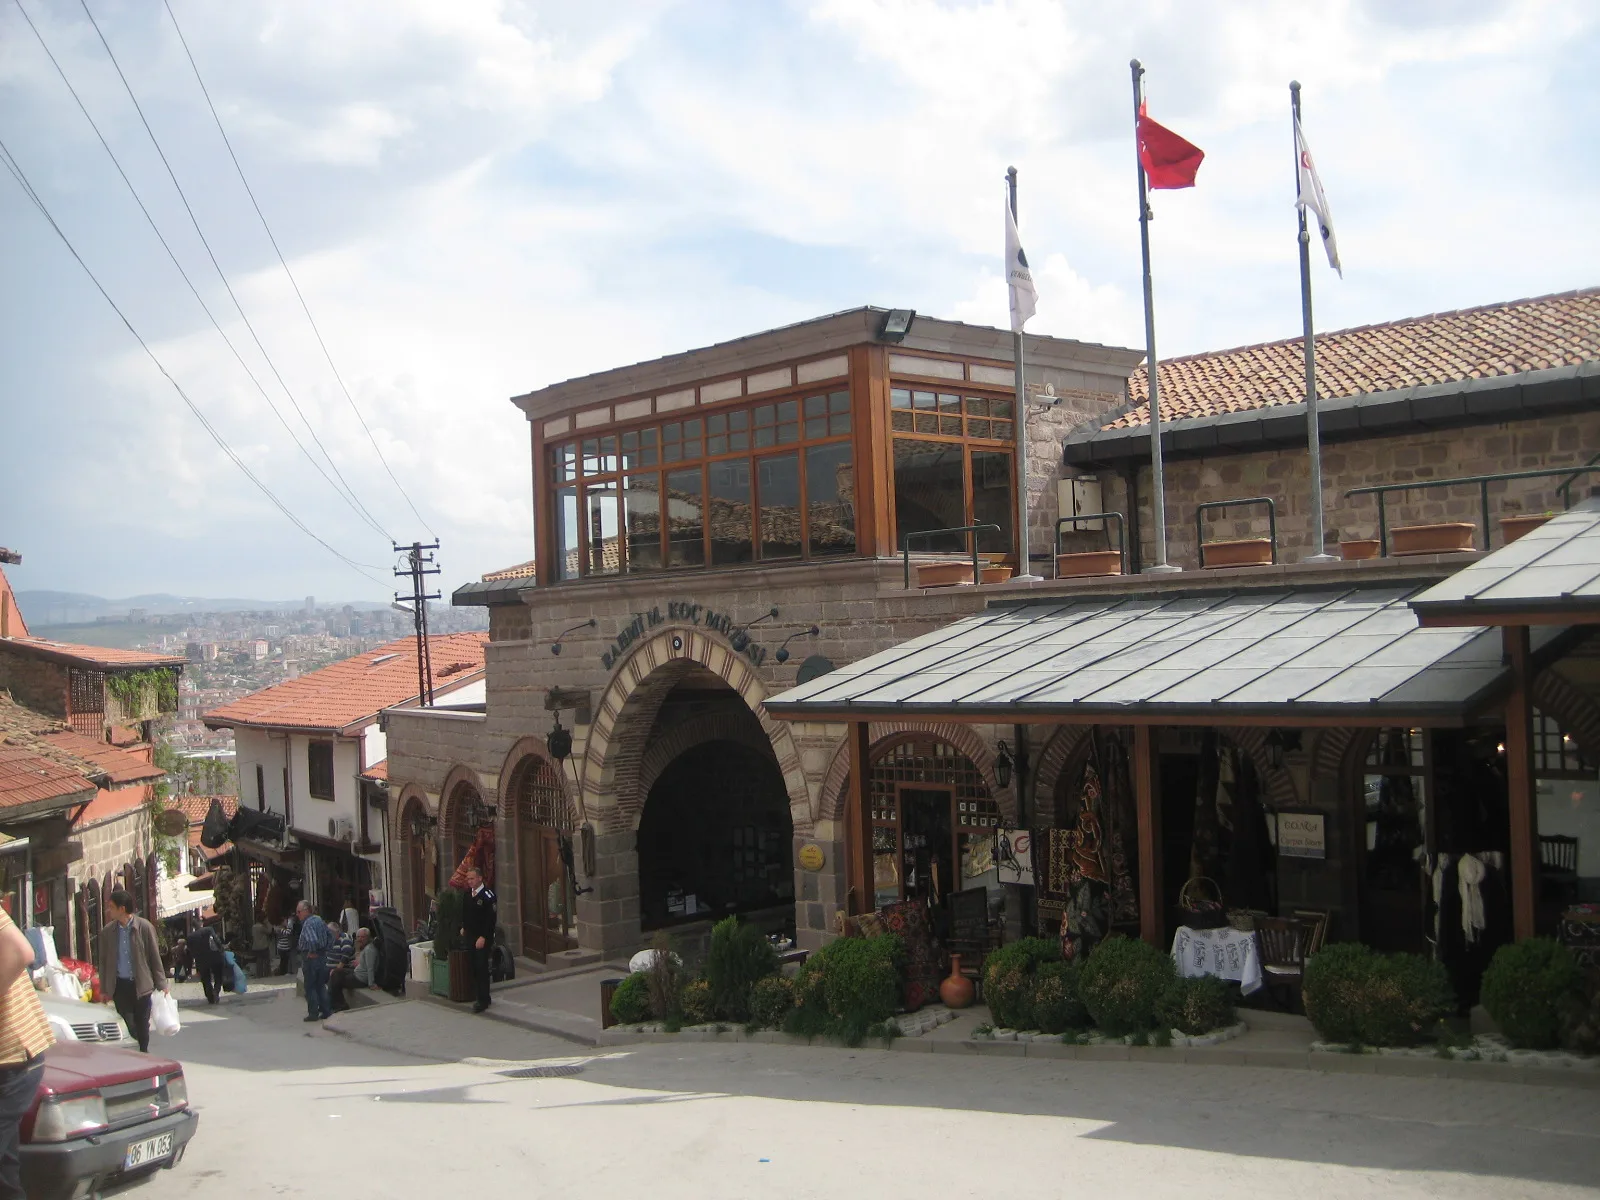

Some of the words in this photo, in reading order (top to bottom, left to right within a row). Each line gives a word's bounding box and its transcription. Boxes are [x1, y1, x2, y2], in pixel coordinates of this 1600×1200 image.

[668, 601, 703, 624] KOÇ
[130, 1144, 142, 1164] 06
[157, 1134, 172, 1155] 053
